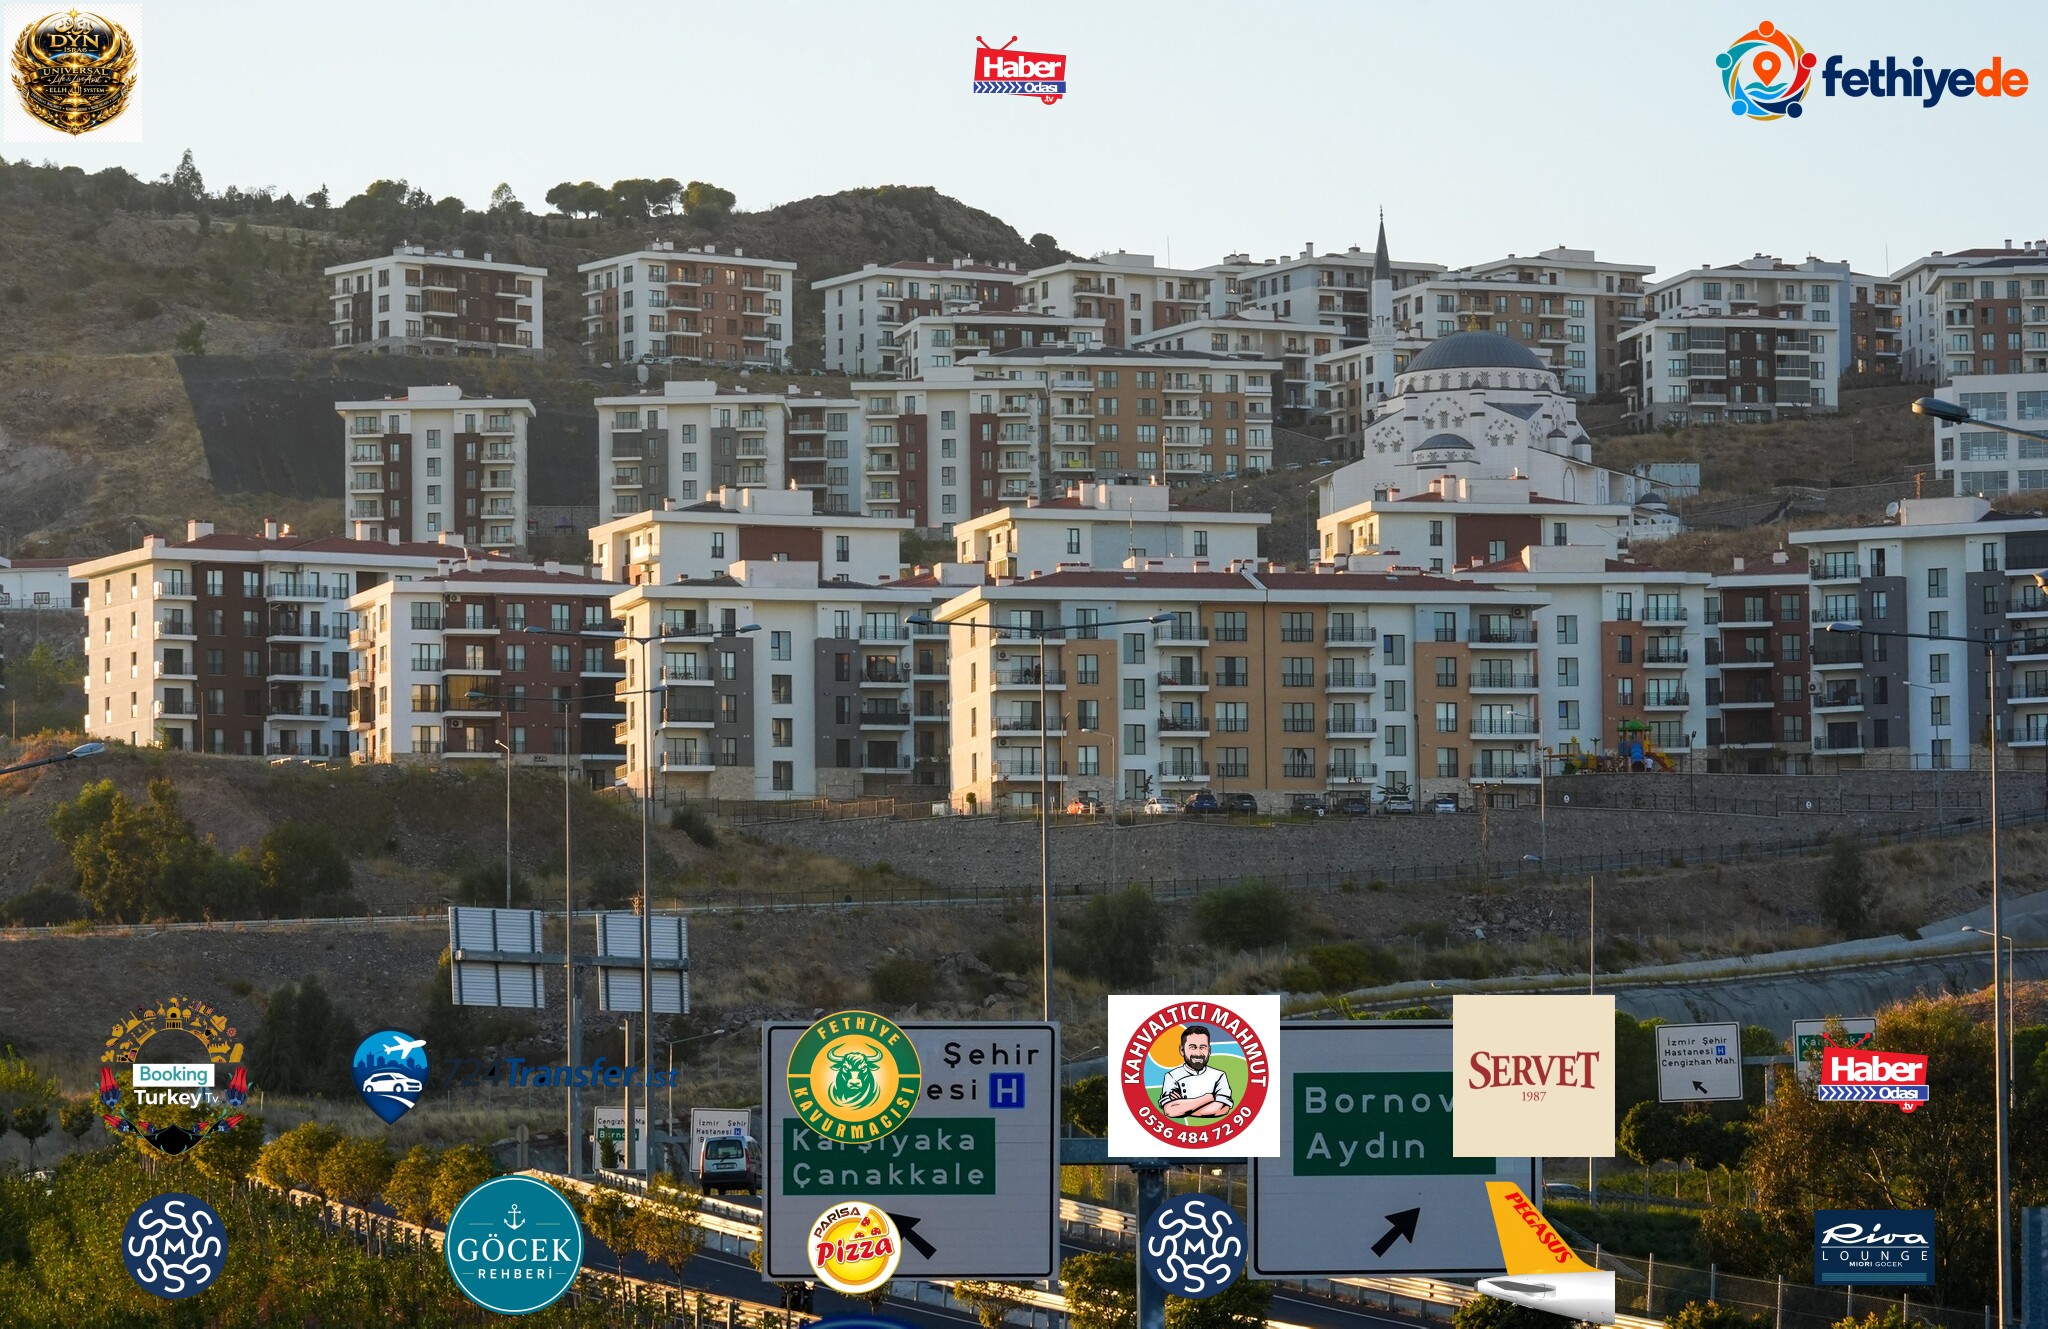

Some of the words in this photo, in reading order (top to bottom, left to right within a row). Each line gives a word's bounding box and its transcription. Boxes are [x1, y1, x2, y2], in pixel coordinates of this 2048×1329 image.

[1664, 1048, 1714, 1056] Hastanesi
[1667, 1037, 1696, 1046] İzmir
[1702, 1036, 1728, 1046] Şehir
[943, 1042, 1039, 1069] Şehir
[1661, 1058, 1713, 1068] Cengizhan
[1715, 1057, 1738, 1065] Mah.
[1305, 1086, 1453, 1113] Bornov
[1305, 1131, 1426, 1168] Aydın
[792, 1162, 984, 1189] Çanakkale
